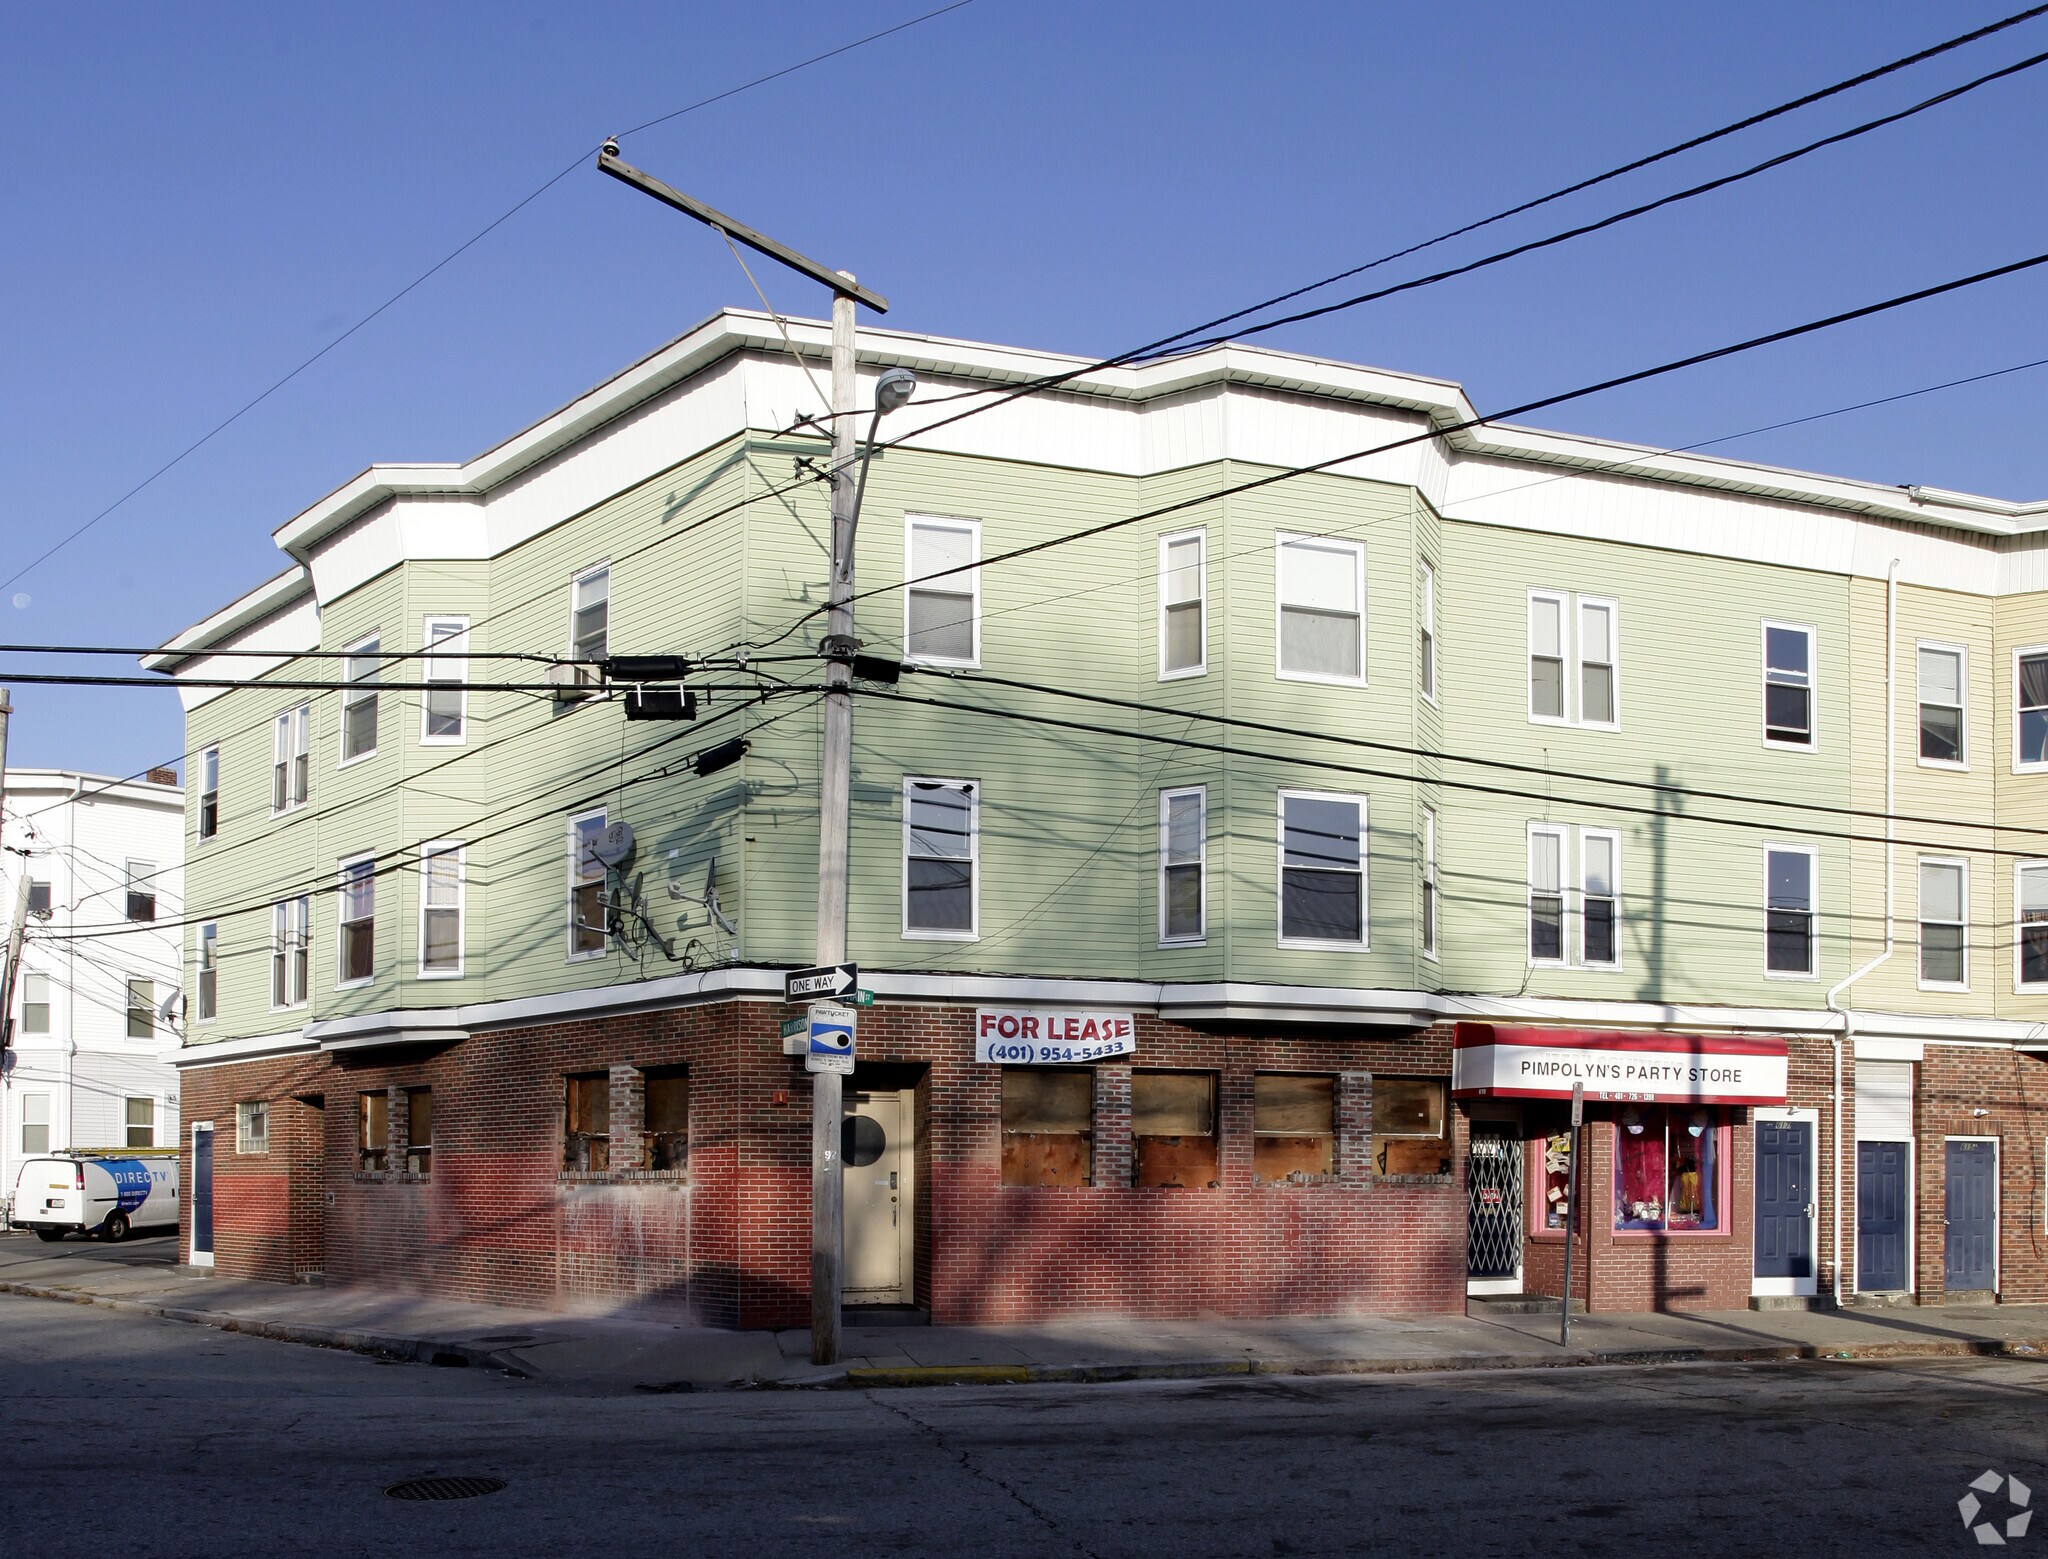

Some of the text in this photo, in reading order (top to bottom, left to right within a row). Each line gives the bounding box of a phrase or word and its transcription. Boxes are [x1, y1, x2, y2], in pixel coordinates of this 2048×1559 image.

[792, 976, 835, 993] ONE WAY
[815, 1009, 850, 1017] PAWTUCKET
[980, 1014, 1131, 1042] FOR LEASE
[988, 1042, 1124, 1064] (401) 954-5433
[1520, 1060, 1743, 1083] PIMPOLYN'S PARTY STORE
[115, 1171, 166, 1184] DIRECTV
